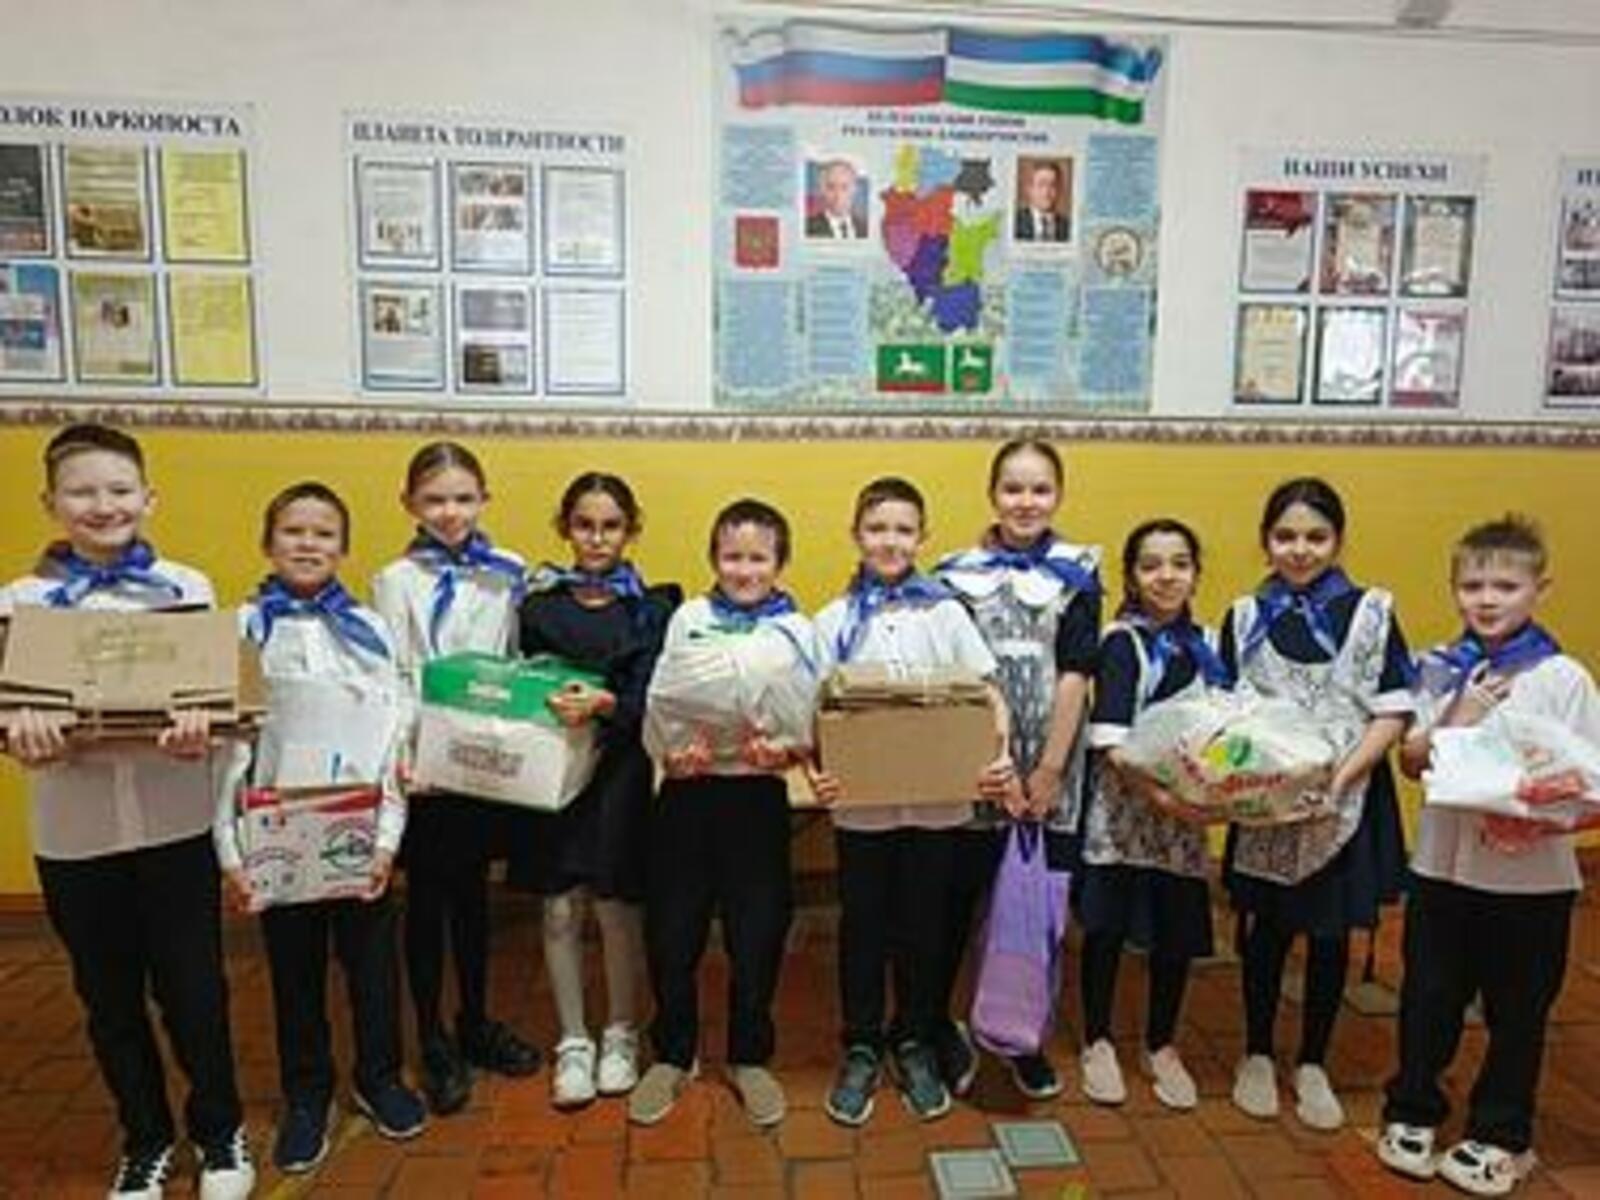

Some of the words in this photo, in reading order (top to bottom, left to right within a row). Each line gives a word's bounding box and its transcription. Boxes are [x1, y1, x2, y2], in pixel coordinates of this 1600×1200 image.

[70, 108, 240, 136] НАРКОПОСТА
[352, 121, 450, 145] ПЛАНЕТА
[1283, 156, 1354, 178] НАШИ
